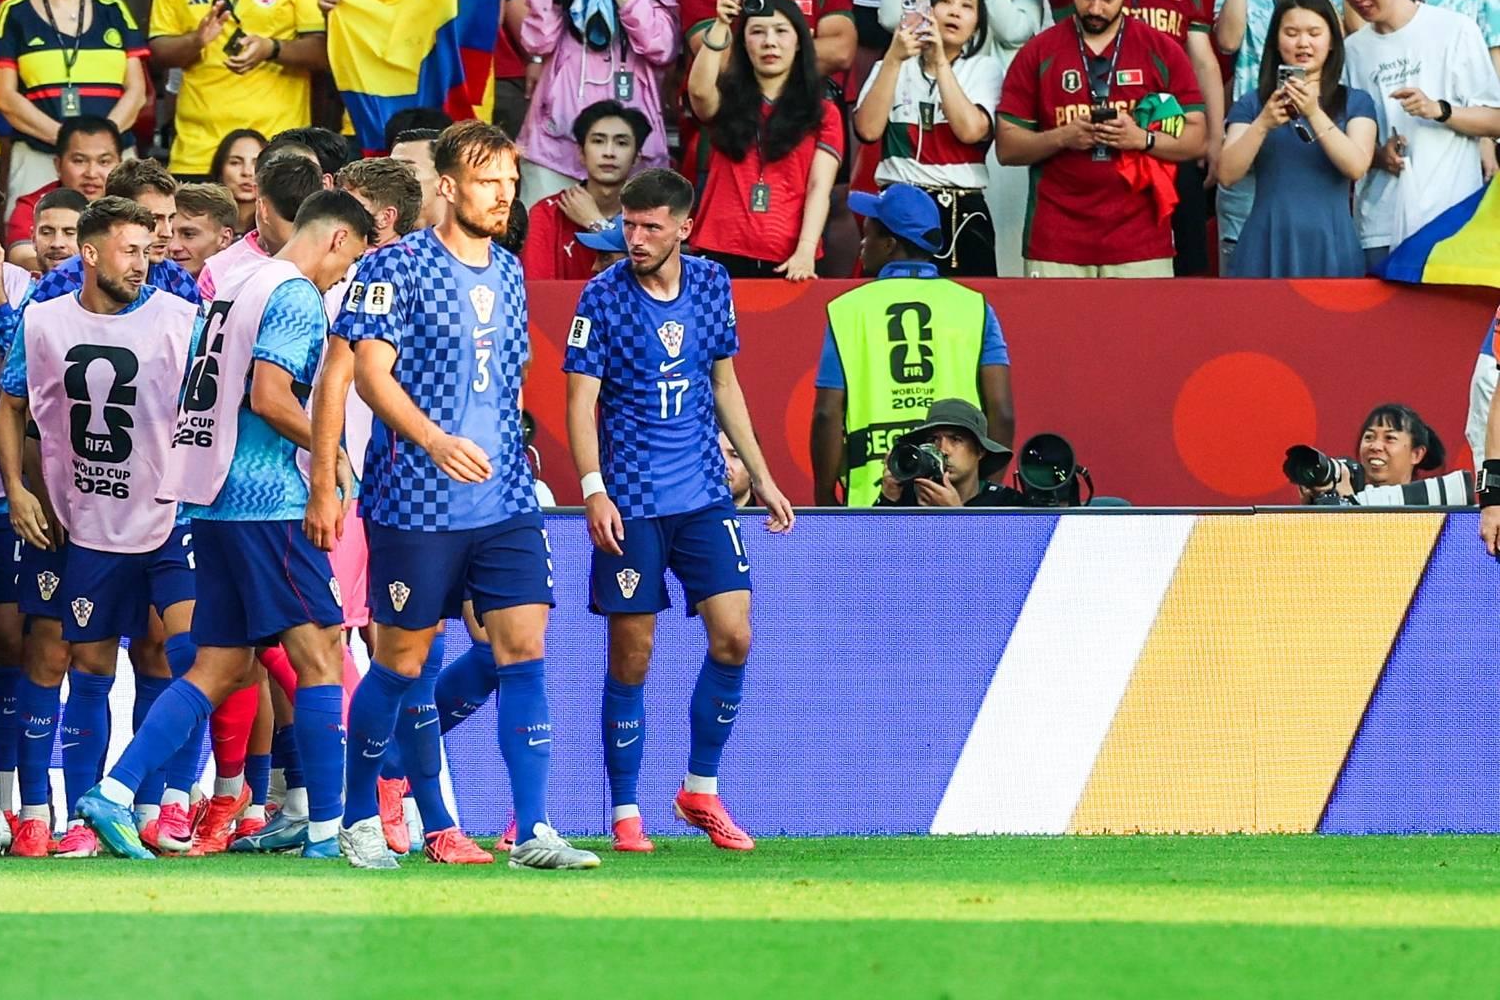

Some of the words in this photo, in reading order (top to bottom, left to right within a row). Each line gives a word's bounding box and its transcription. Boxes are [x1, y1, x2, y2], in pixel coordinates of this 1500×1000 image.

[472, 348, 490, 393] 3
[891, 388, 922, 396] WORLD
[656, 378, 690, 420] 17
[892, 396, 935, 410] 2026
[190, 418, 215, 429] CUP
[85, 437, 114, 454] FIFA
[106, 469, 131, 481] CUP
[30, 715, 52, 725] HNS
[618, 720, 640, 729] HNS
